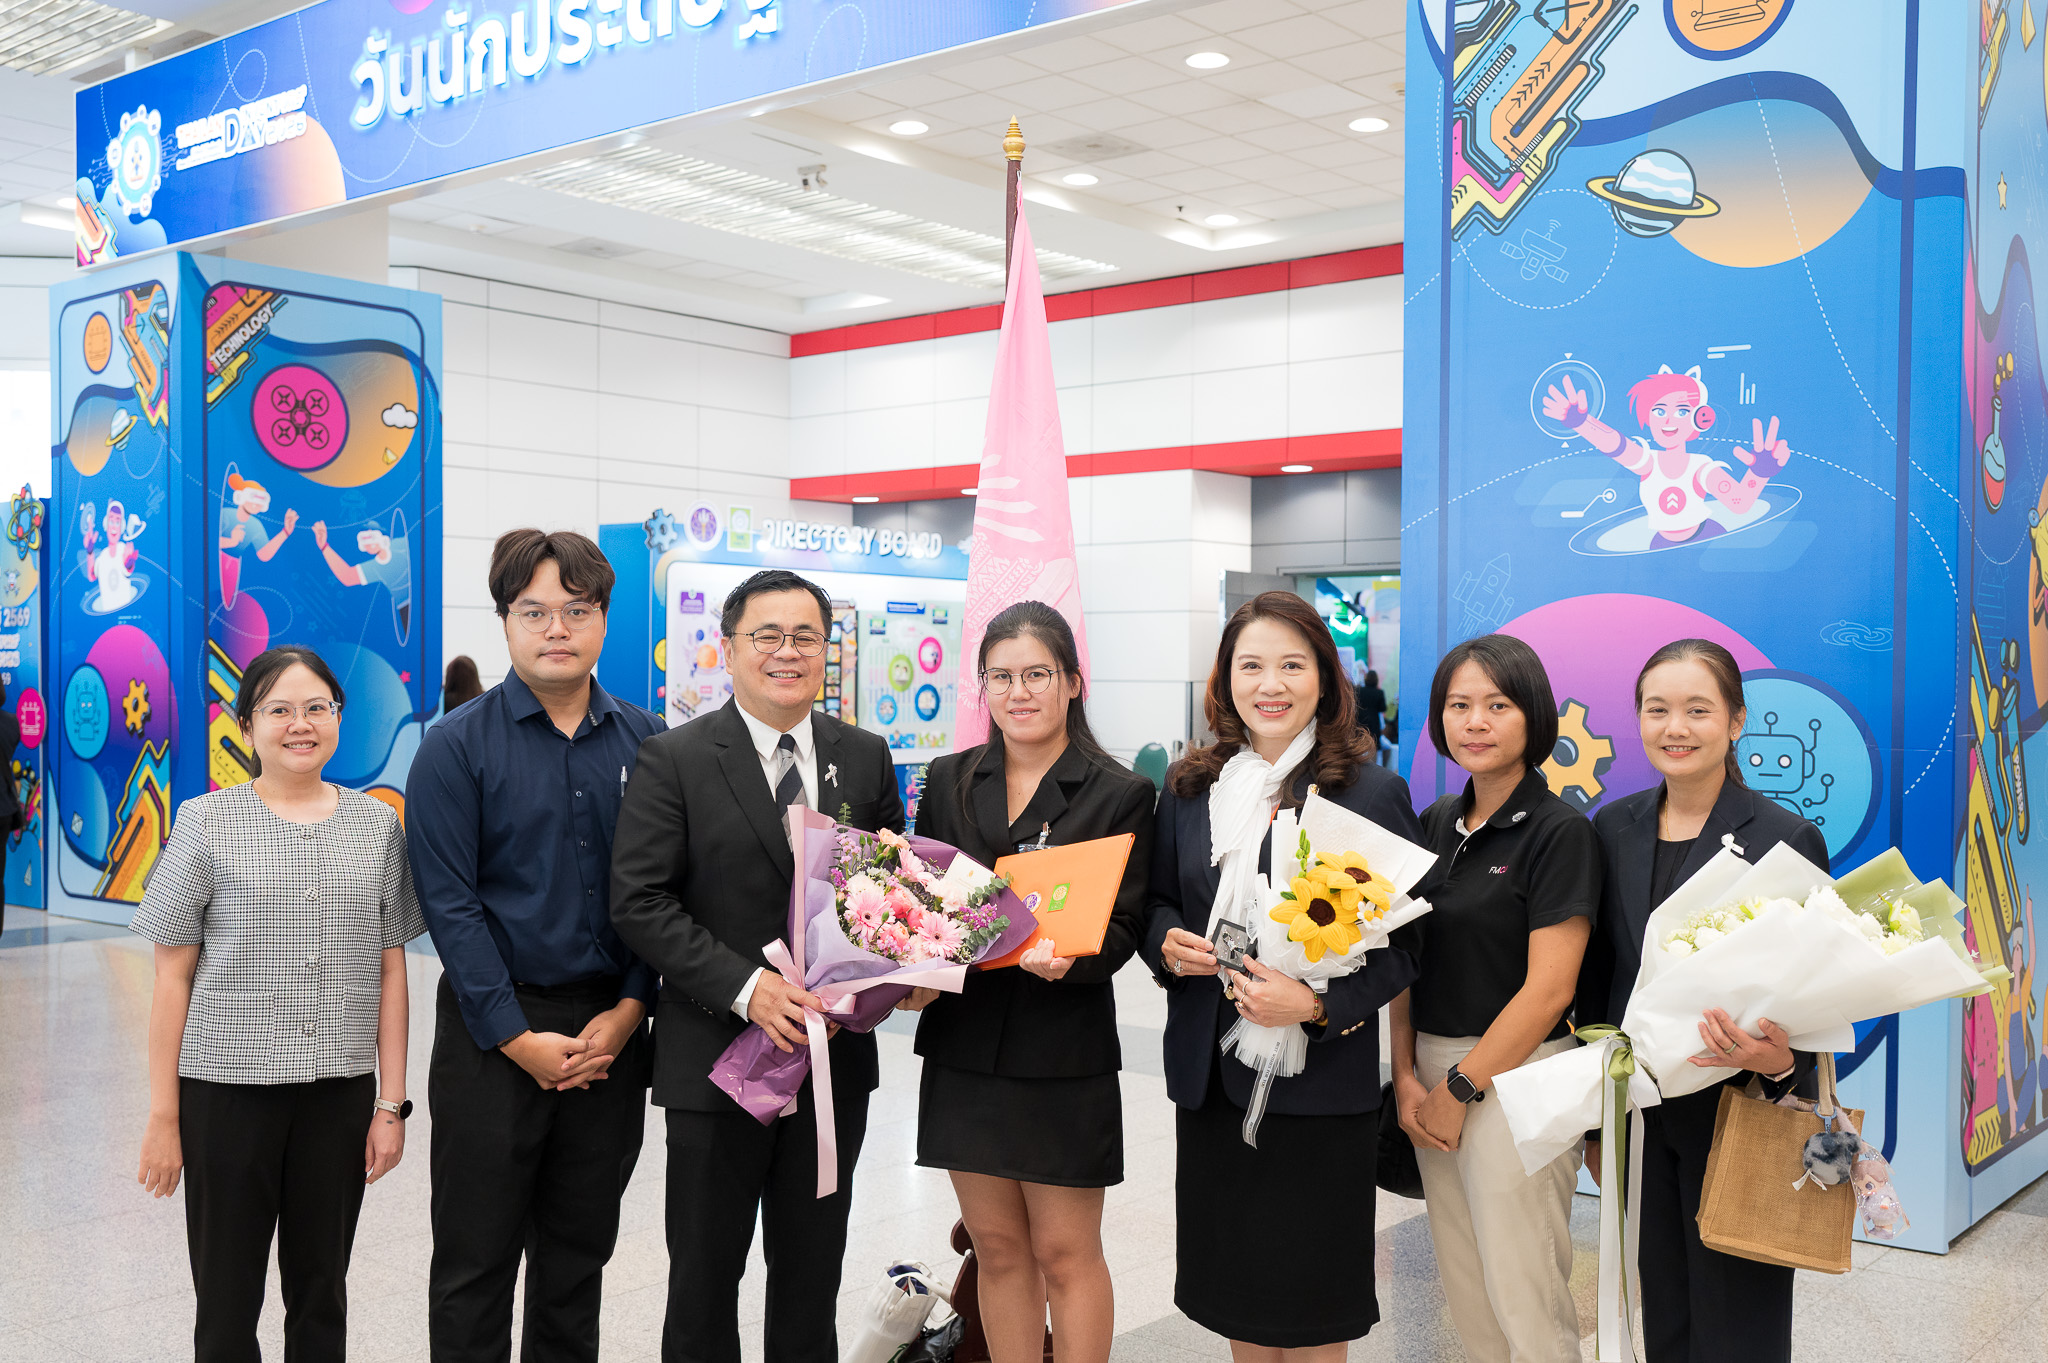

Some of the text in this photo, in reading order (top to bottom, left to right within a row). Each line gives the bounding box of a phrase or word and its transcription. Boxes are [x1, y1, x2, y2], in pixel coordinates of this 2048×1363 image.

[209, 303, 274, 367] TECHNOLOGY
[758, 518, 943, 558] DIRECTORY BOARD
[3, 605, 31, 628] 2569
